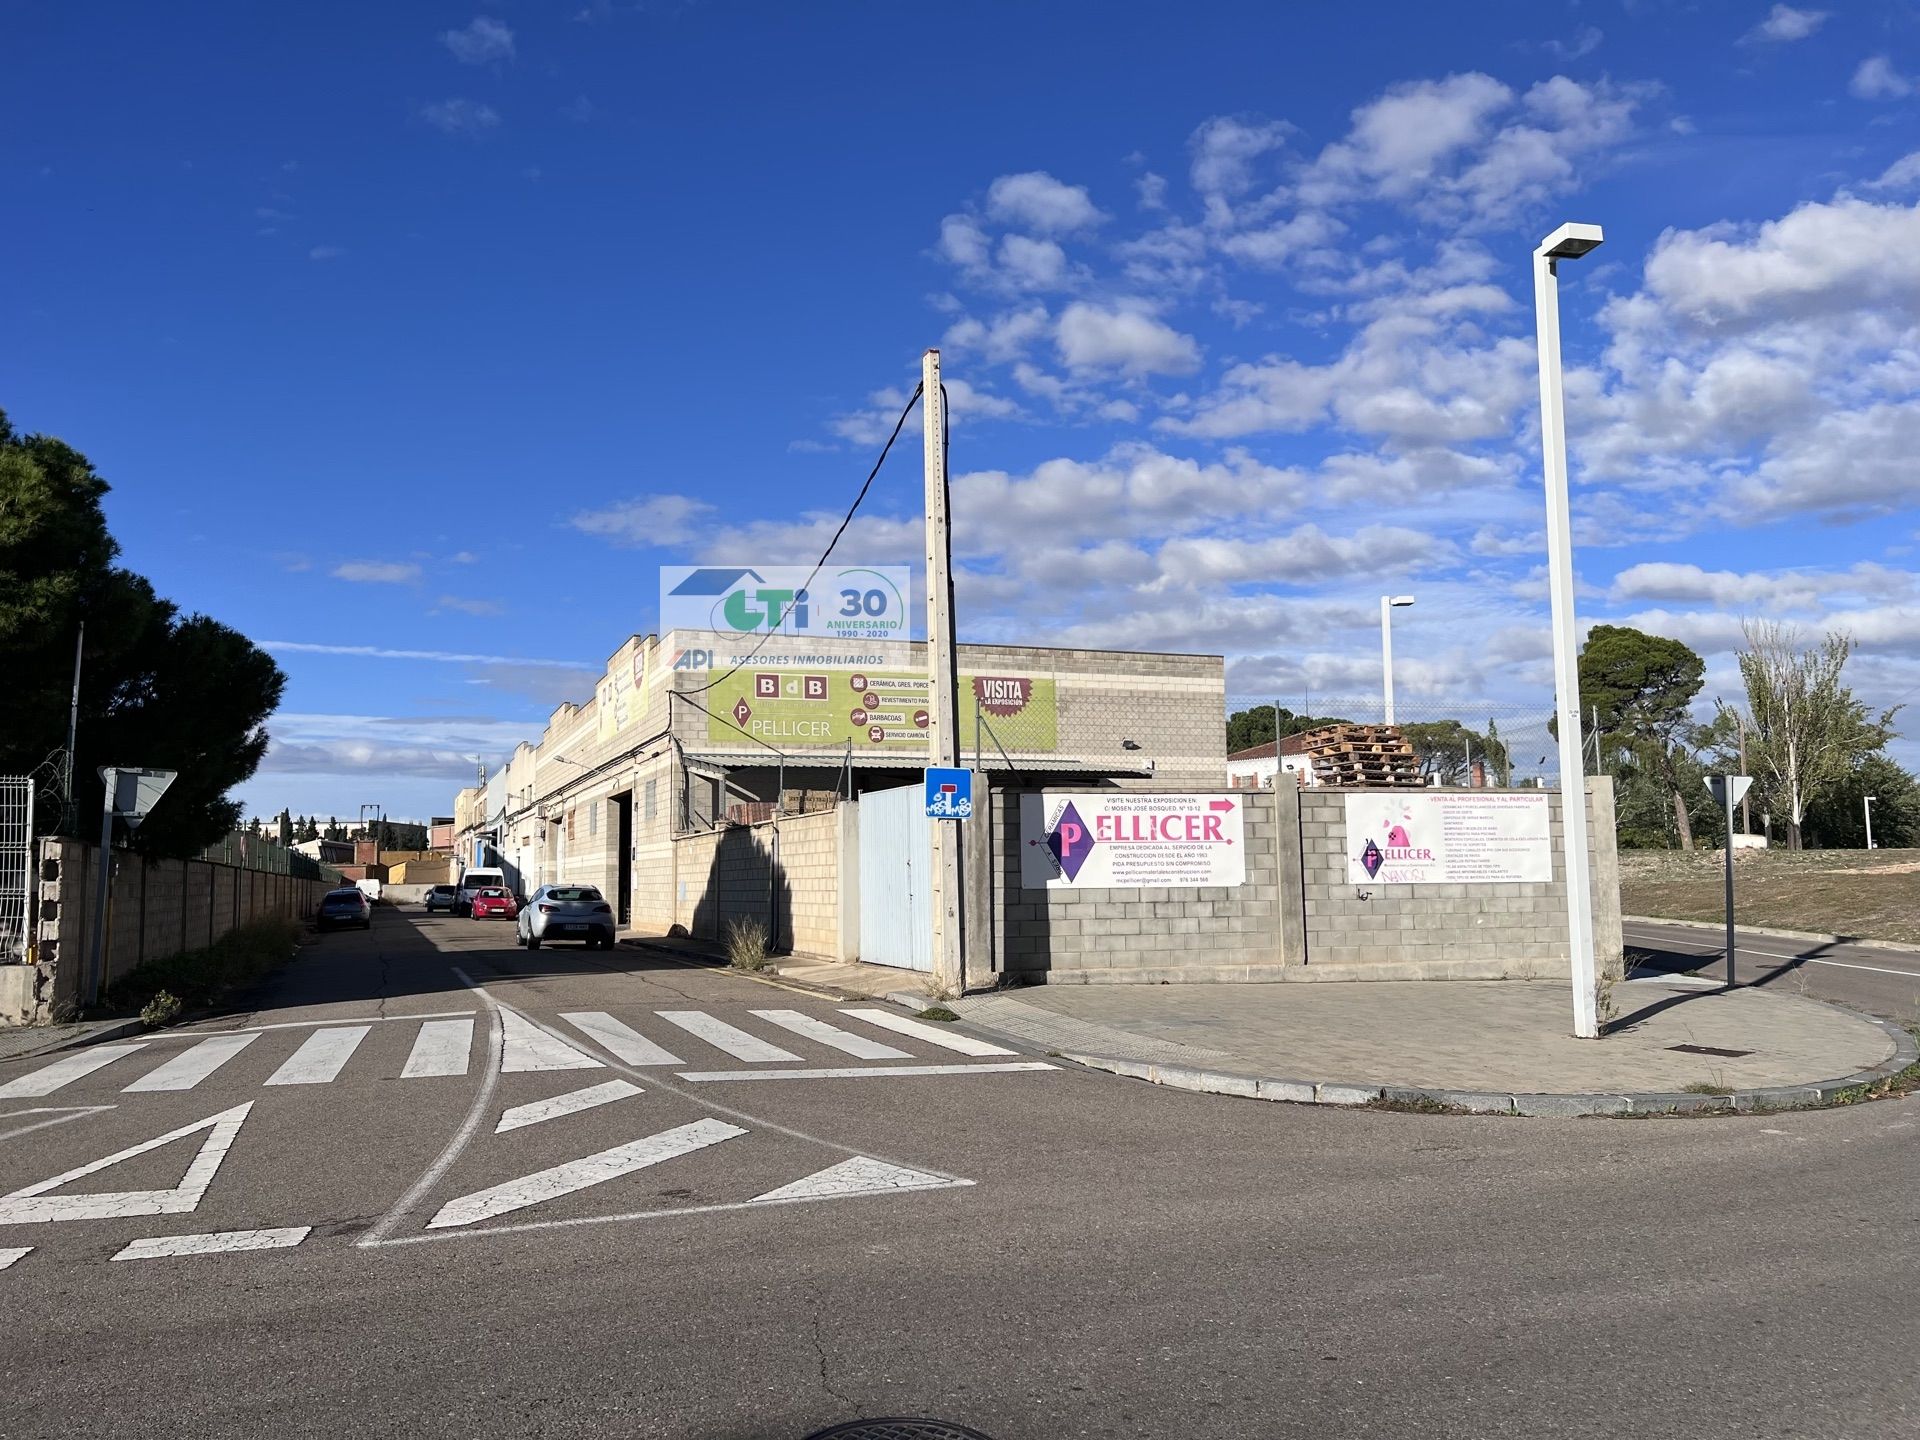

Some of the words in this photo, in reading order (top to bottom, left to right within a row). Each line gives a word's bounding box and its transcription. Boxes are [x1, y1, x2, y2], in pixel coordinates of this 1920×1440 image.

[982, 680, 1022, 698] VISITA
[992, 698, 1023, 706] EXPOSICIÓN
[738, 705, 748, 719] P
[869, 714, 902, 722] BARBACOAS
[752, 720, 832, 737] PELLICER
[907, 731, 925, 739] CAMIÓN
